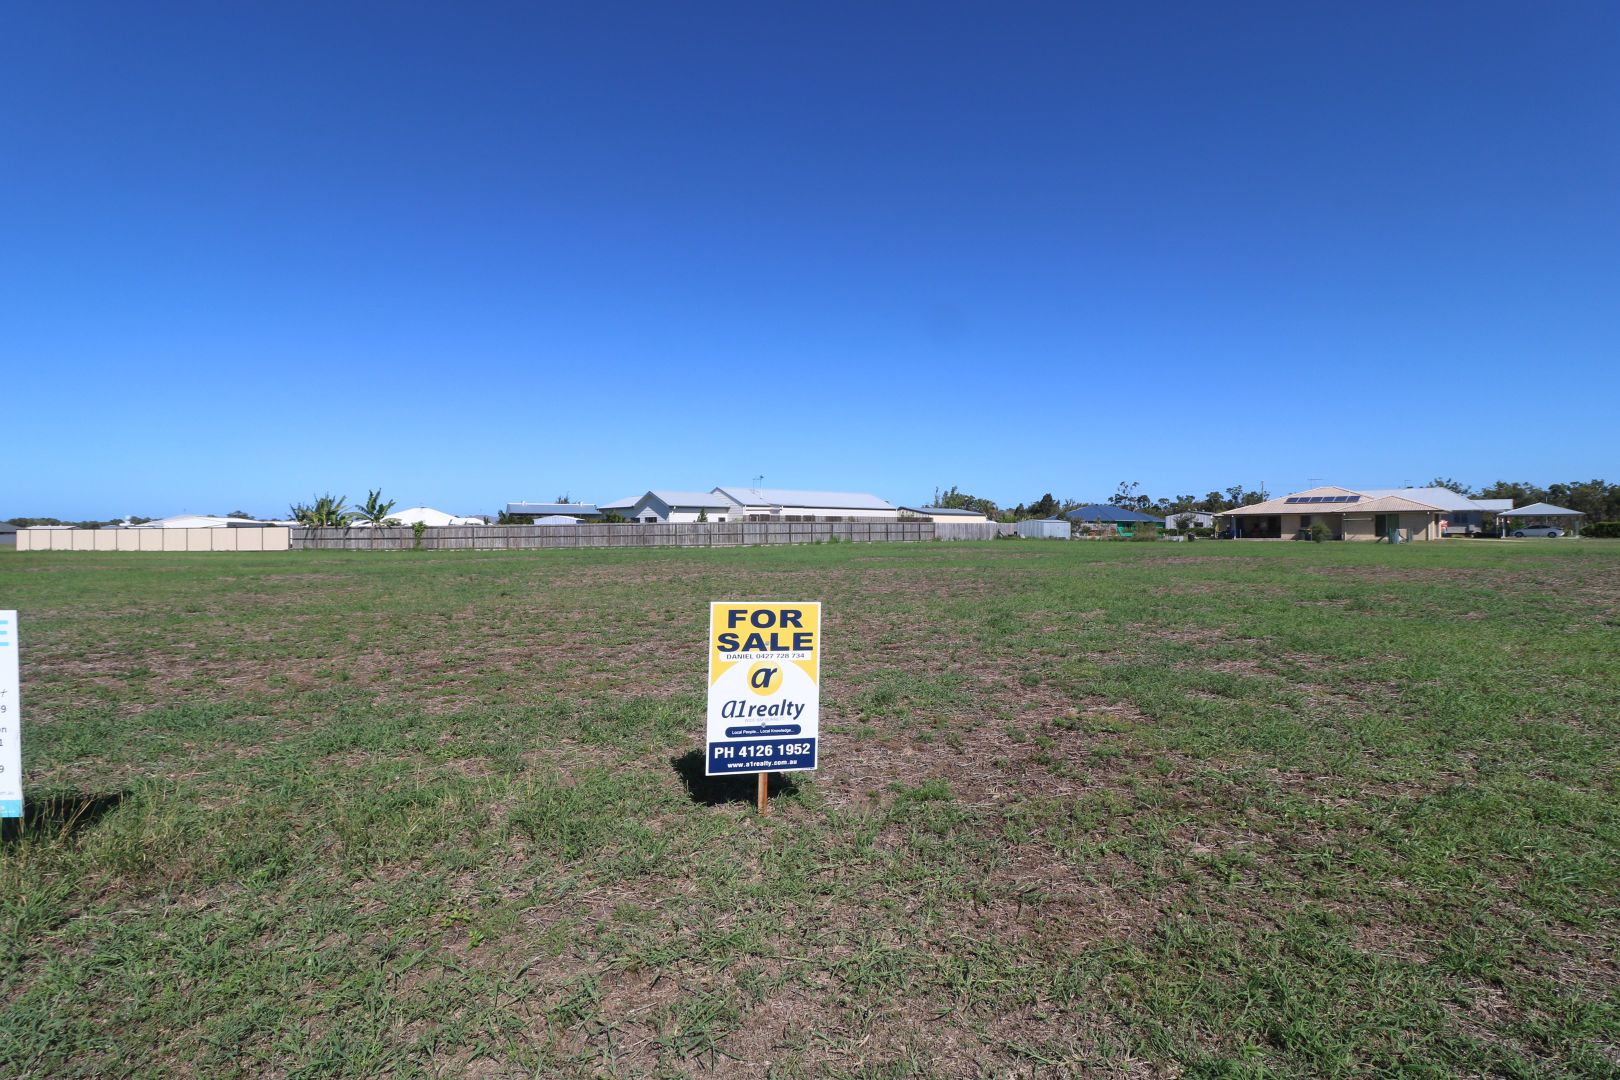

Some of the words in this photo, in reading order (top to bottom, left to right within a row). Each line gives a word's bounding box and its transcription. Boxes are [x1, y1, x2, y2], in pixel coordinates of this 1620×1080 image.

[727, 609, 803, 629] FOR
[716, 632, 814, 653] SALE
[721, 698, 805, 721] a1realty
[714, 747, 734, 759] PH
[738, 744, 773, 757] 4126
[777, 743, 811, 755] 1952
[727, 759, 798, 768] www.a1realty.com.au
